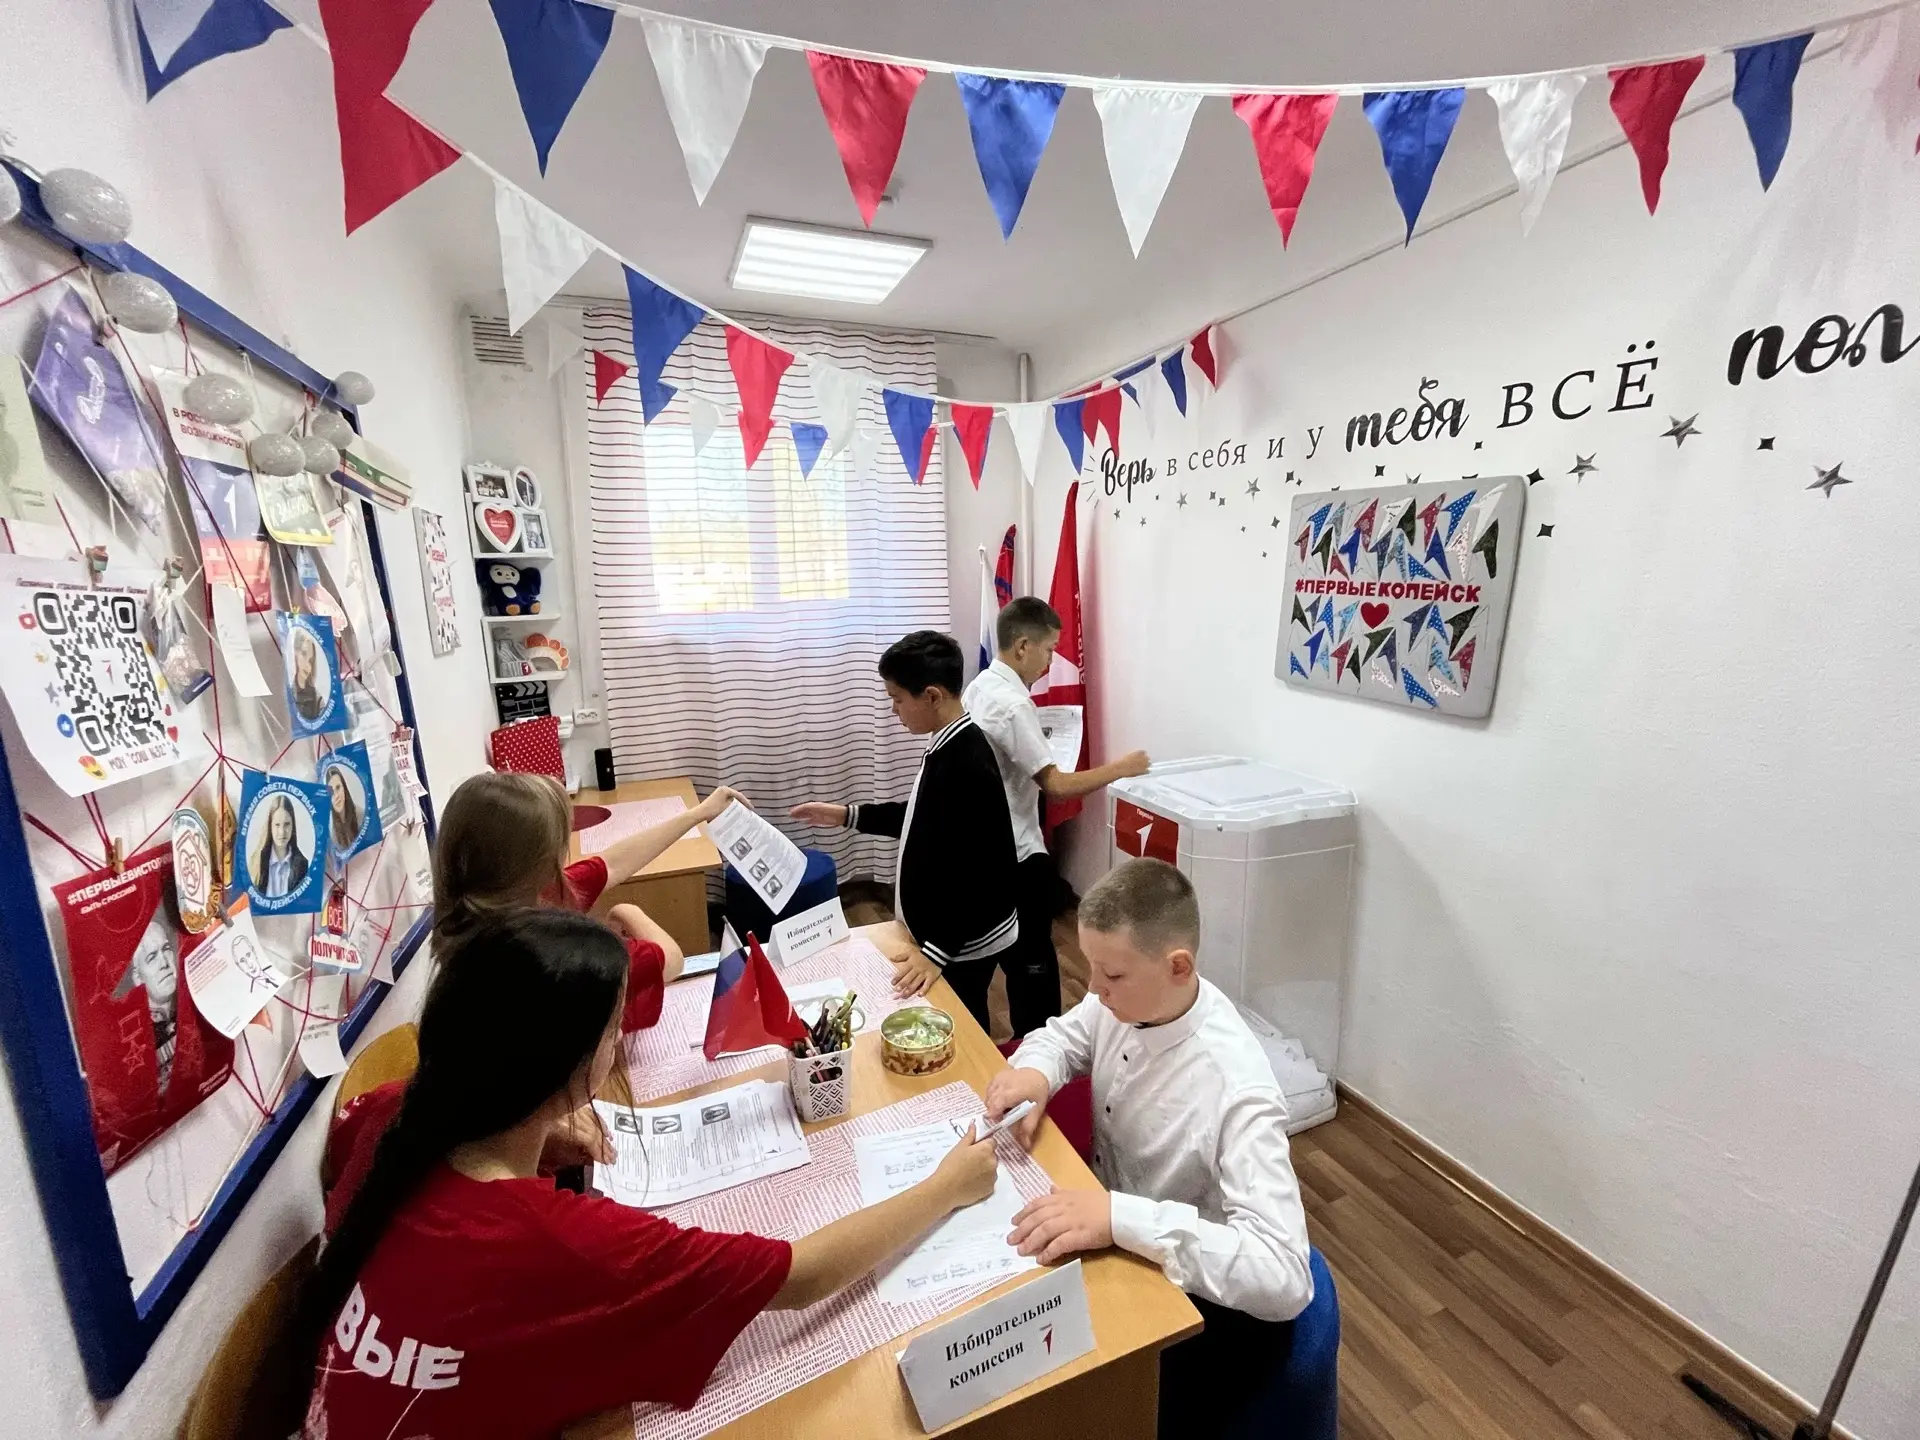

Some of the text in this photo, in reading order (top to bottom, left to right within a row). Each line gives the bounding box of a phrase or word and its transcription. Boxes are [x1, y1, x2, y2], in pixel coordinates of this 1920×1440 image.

[1101, 448, 1156, 502] Верь
[1167, 456, 1177, 476] в
[1188, 439, 1246, 470] себя
[1267, 436, 1284, 461] и
[1306, 425, 1324, 459] у
[1345, 377, 1470, 453] тебя
[1497, 340, 1659, 430] ВСЁ
[257, 782, 287, 799] СОВЕТА
[287, 784, 317, 816] ПЕРВЫХ
[328, 906, 343, 928] ВСЁ
[787, 913, 834, 939] Избирательная
[790, 932, 821, 951] комиссия
[945, 1294, 1063, 1362] Избирательная
[949, 1341, 1025, 1390] комиссия
